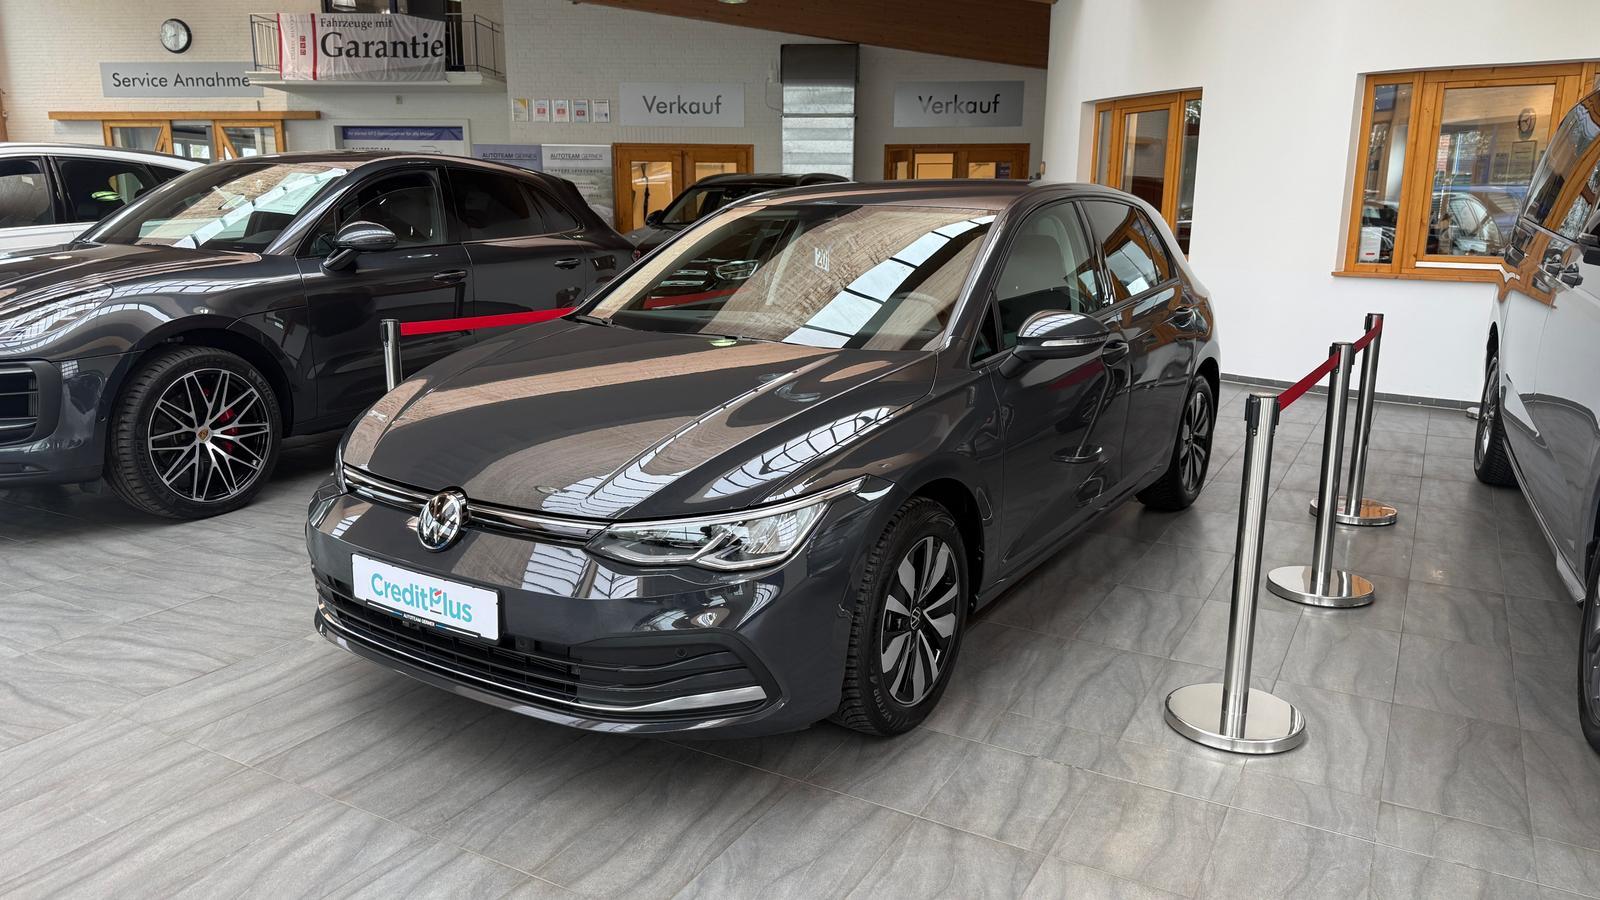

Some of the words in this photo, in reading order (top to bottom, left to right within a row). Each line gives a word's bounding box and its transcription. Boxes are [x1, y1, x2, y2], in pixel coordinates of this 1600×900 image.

[321, 17, 372, 31] Fahrzeuge
[376, 18, 394, 29] mit
[320, 31, 445, 59] Garantie
[112, 72, 168, 88] Service
[173, 71, 250, 88] Annahme
[642, 94, 722, 115] Verkauf
[918, 93, 1001, 114] Verkauf
[482, 152, 514, 160] AUTOTEAM
[550, 152, 580, 160] AUTOTEAM
[370, 572, 473, 623] CreditPlus
